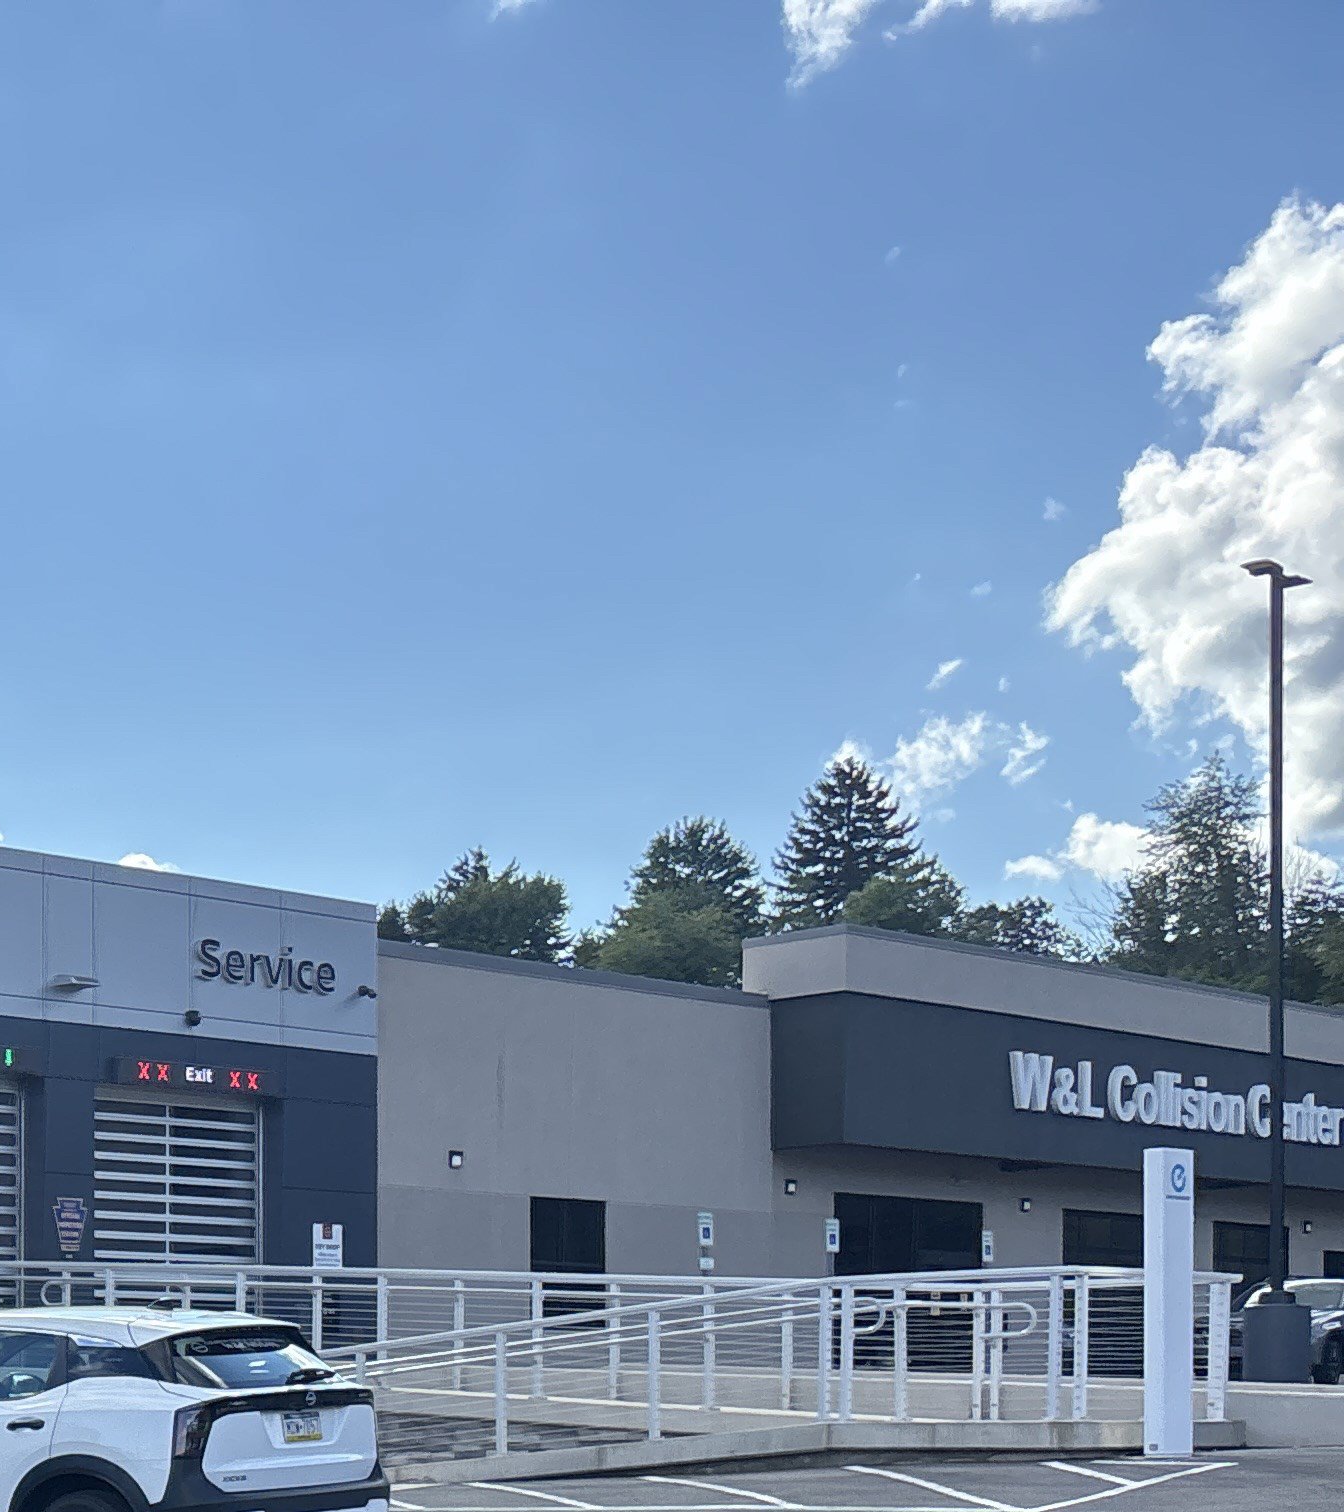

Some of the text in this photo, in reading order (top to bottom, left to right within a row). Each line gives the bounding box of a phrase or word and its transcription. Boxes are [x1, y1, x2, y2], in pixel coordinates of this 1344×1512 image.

[196, 938, 336, 995] Service
[185, 1066, 213, 1083] Exit
[1009, 1050, 1104, 1119] W&L
[1107, 1064, 1245, 1136] Collision
